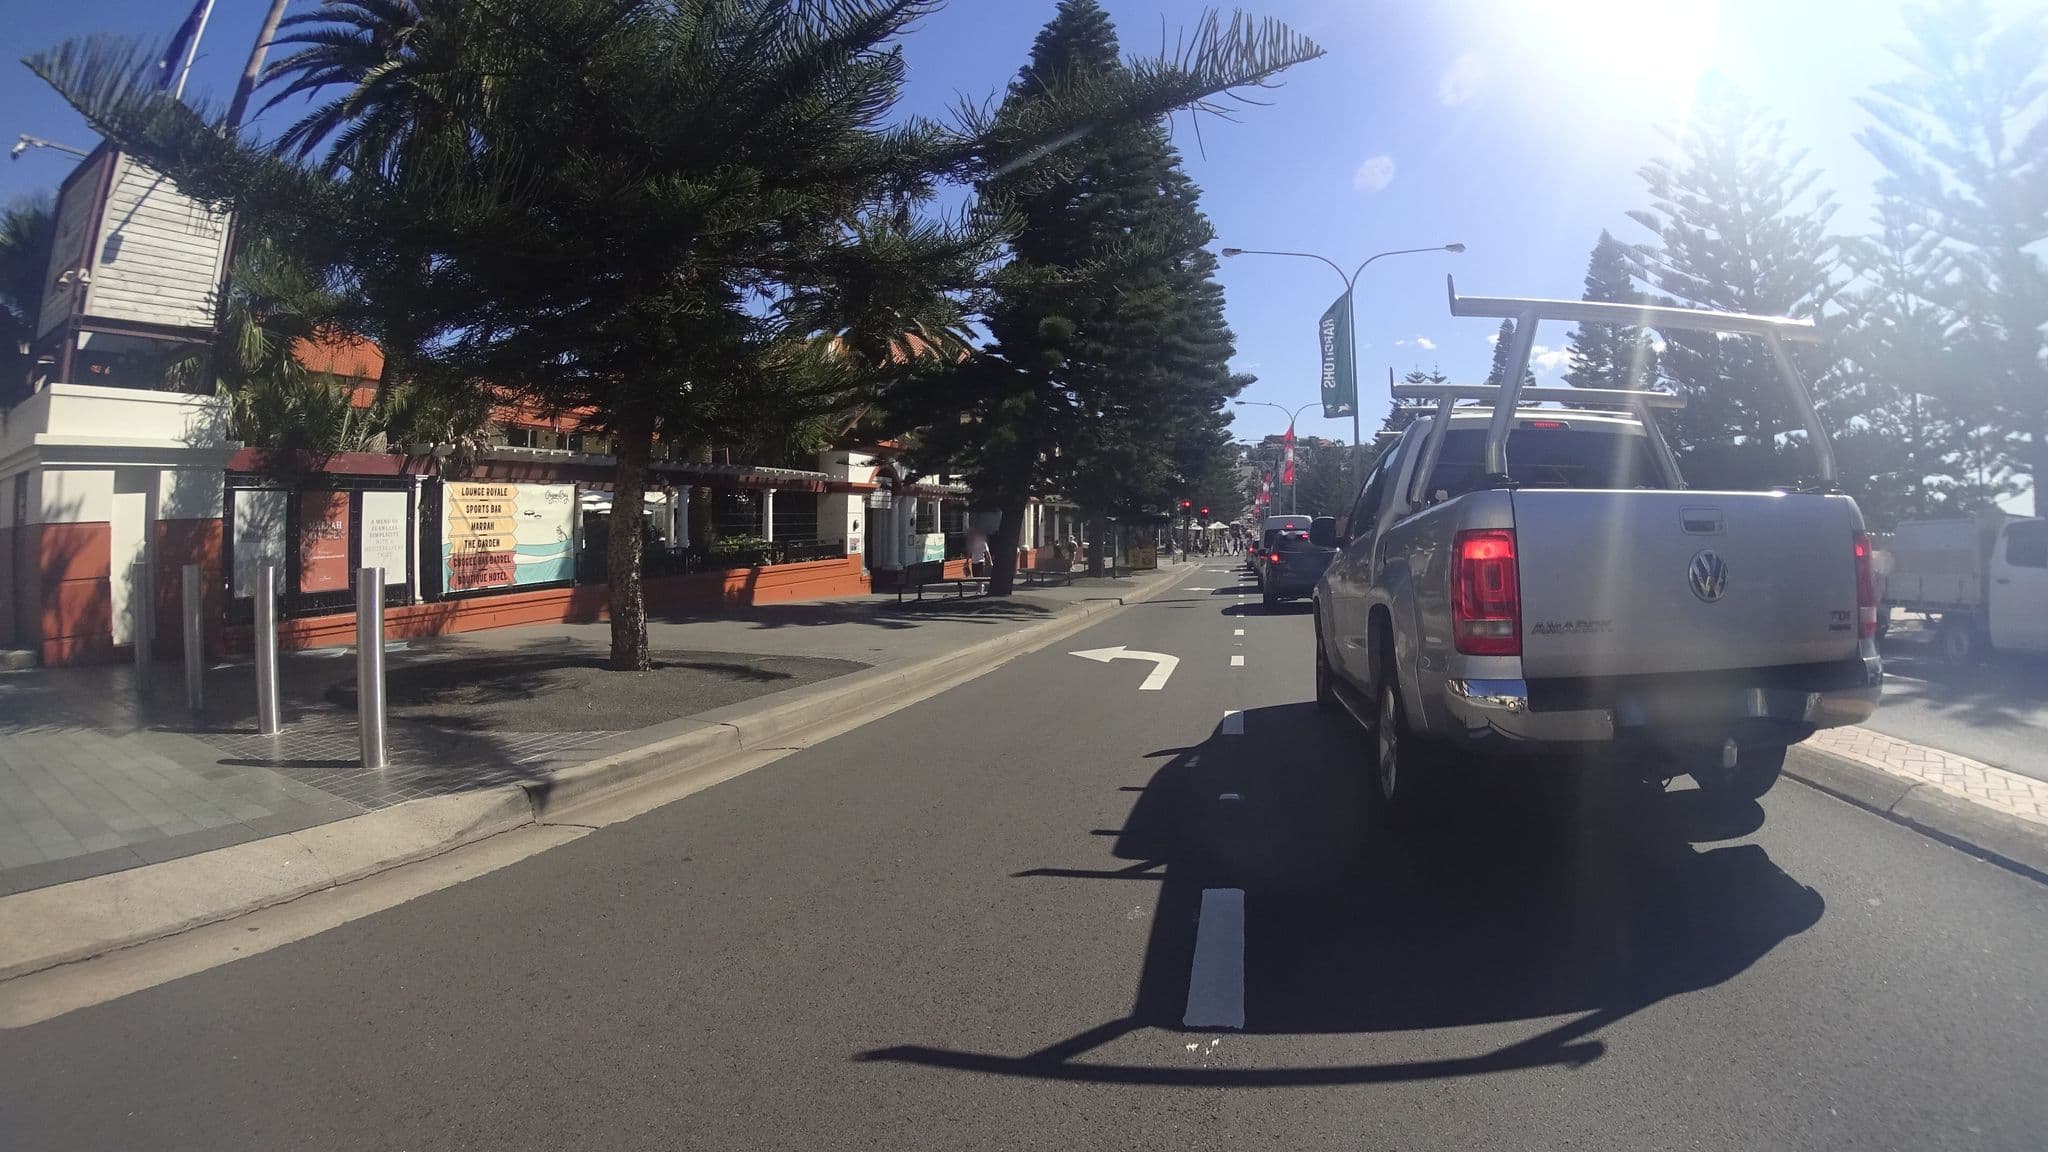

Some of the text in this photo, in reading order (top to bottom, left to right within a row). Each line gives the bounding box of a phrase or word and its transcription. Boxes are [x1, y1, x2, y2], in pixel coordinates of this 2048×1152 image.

[461, 487, 508, 496] LOUNGE ROYALE
[466, 504, 502, 514] SPORTS BAR
[471, 521, 495, 531] MARRAH
[464, 538, 500, 548] THE GARDEN
[453, 556, 477, 568] COOGEE
[490, 554, 511, 564] BARREL
[457, 571, 508, 585] BOUTIQUE HOTEL
